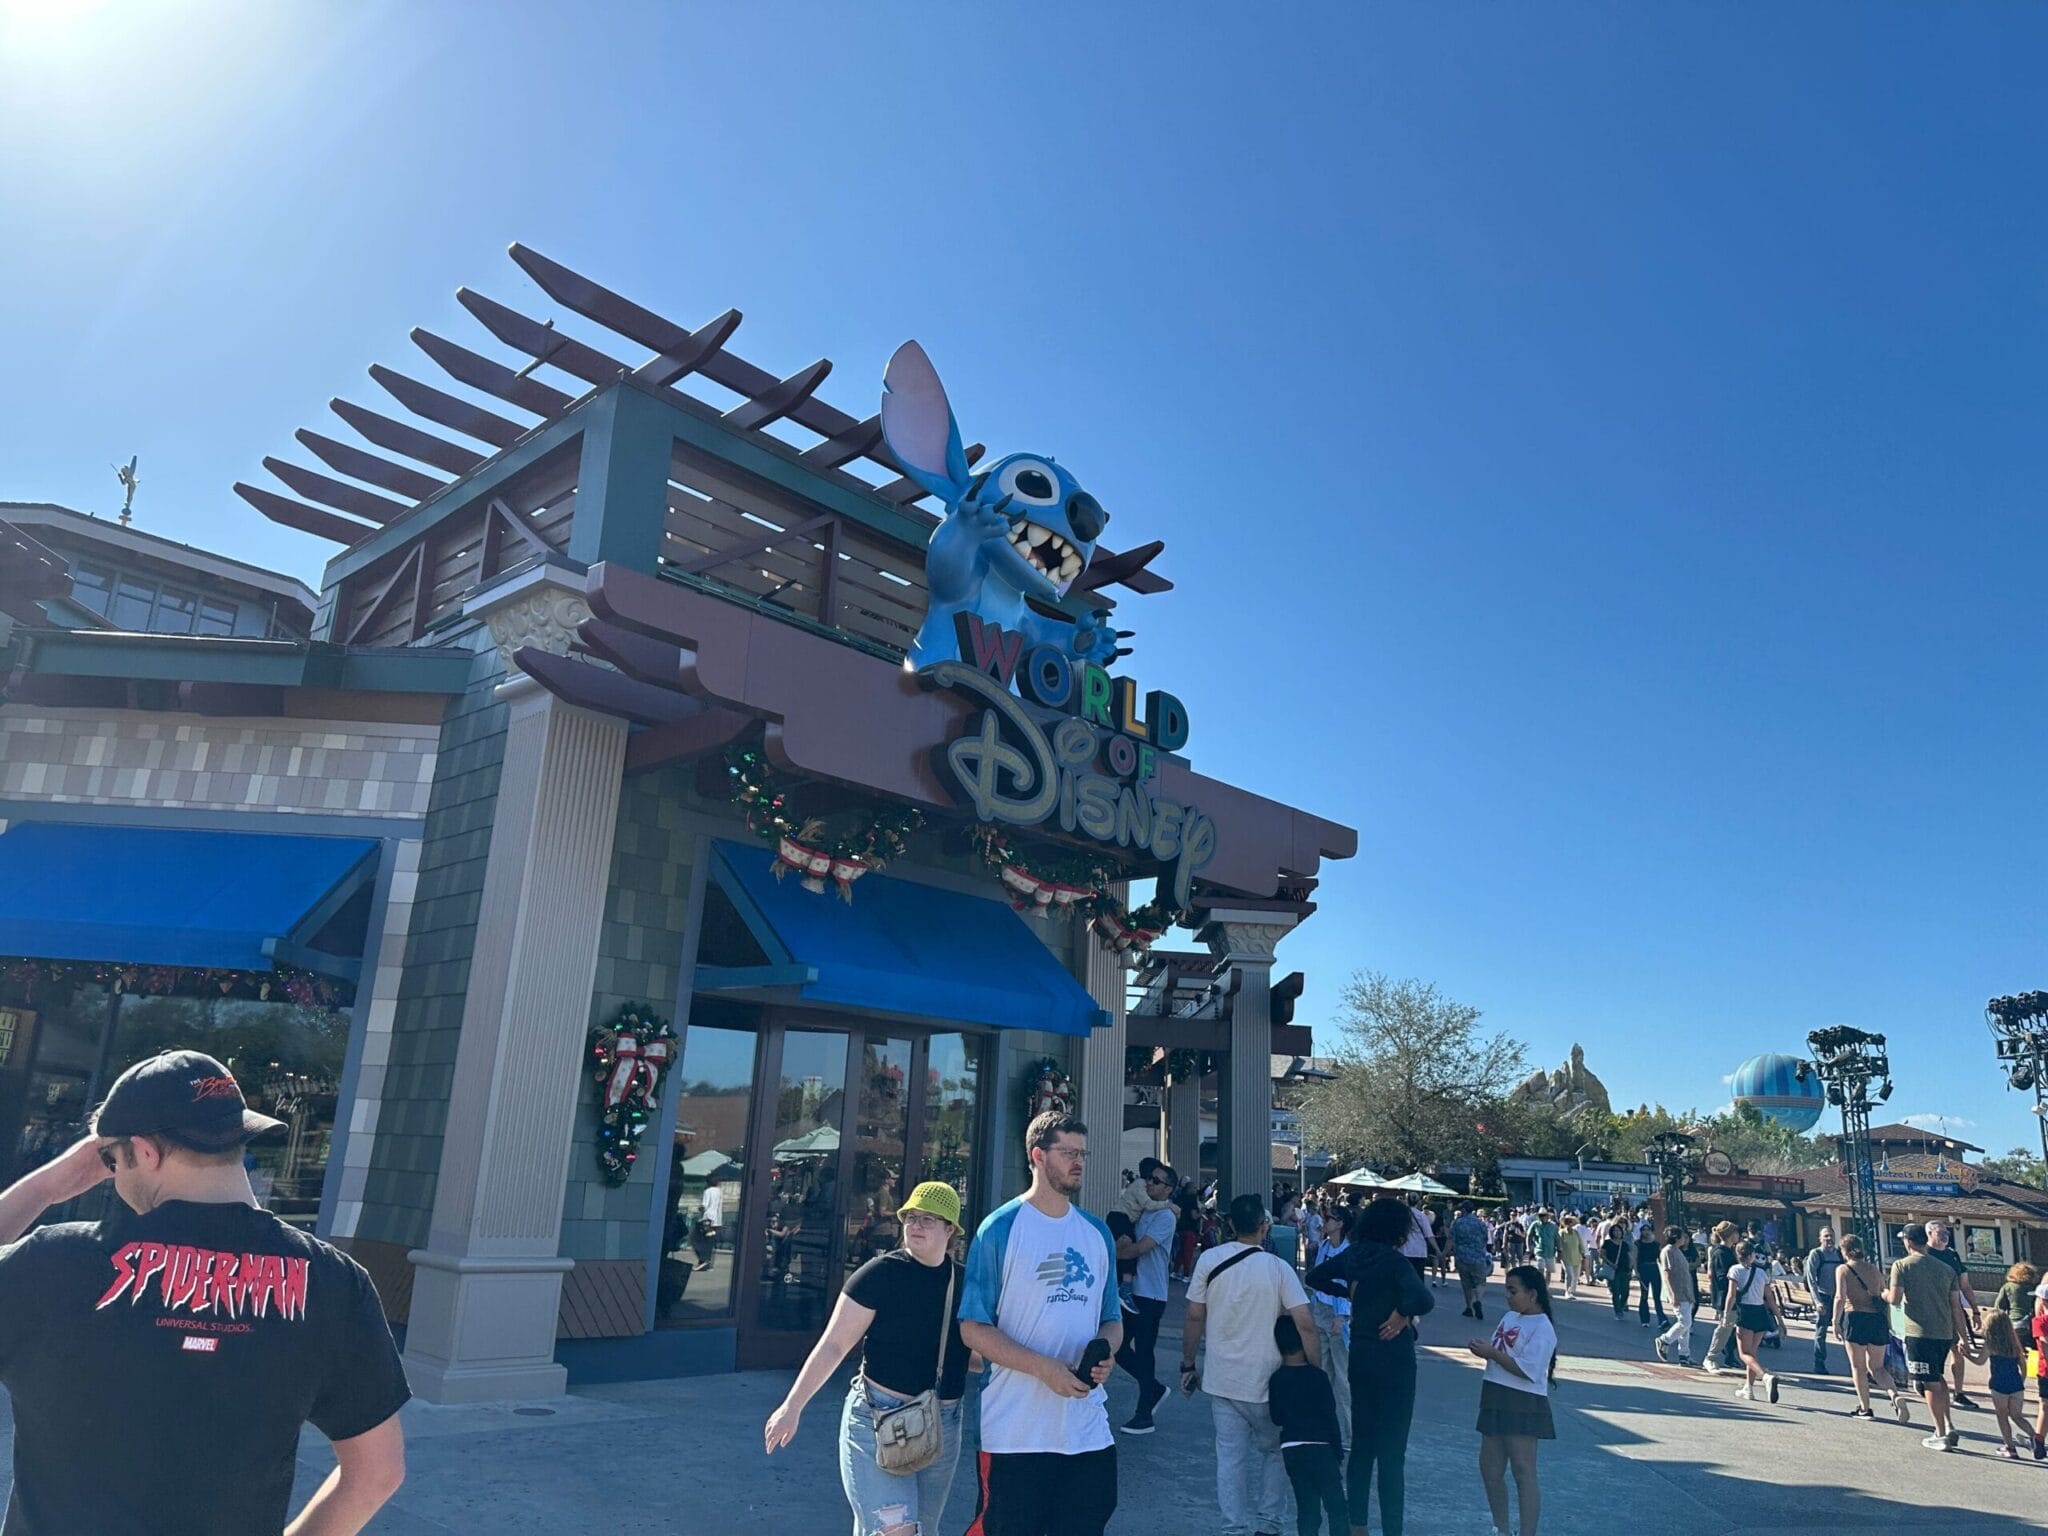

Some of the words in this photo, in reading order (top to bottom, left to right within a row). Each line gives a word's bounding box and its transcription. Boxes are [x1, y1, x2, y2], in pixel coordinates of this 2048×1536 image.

[955, 611, 1189, 751] WORLD
[1108, 734, 1160, 780] OF
[1917, 1171, 1960, 1180] Pretzels
[156, 1317, 207, 1331] UNIVERSAL
[210, 1322, 252, 1333] STUDIOS
[182, 1336, 216, 1351] MARVEL
